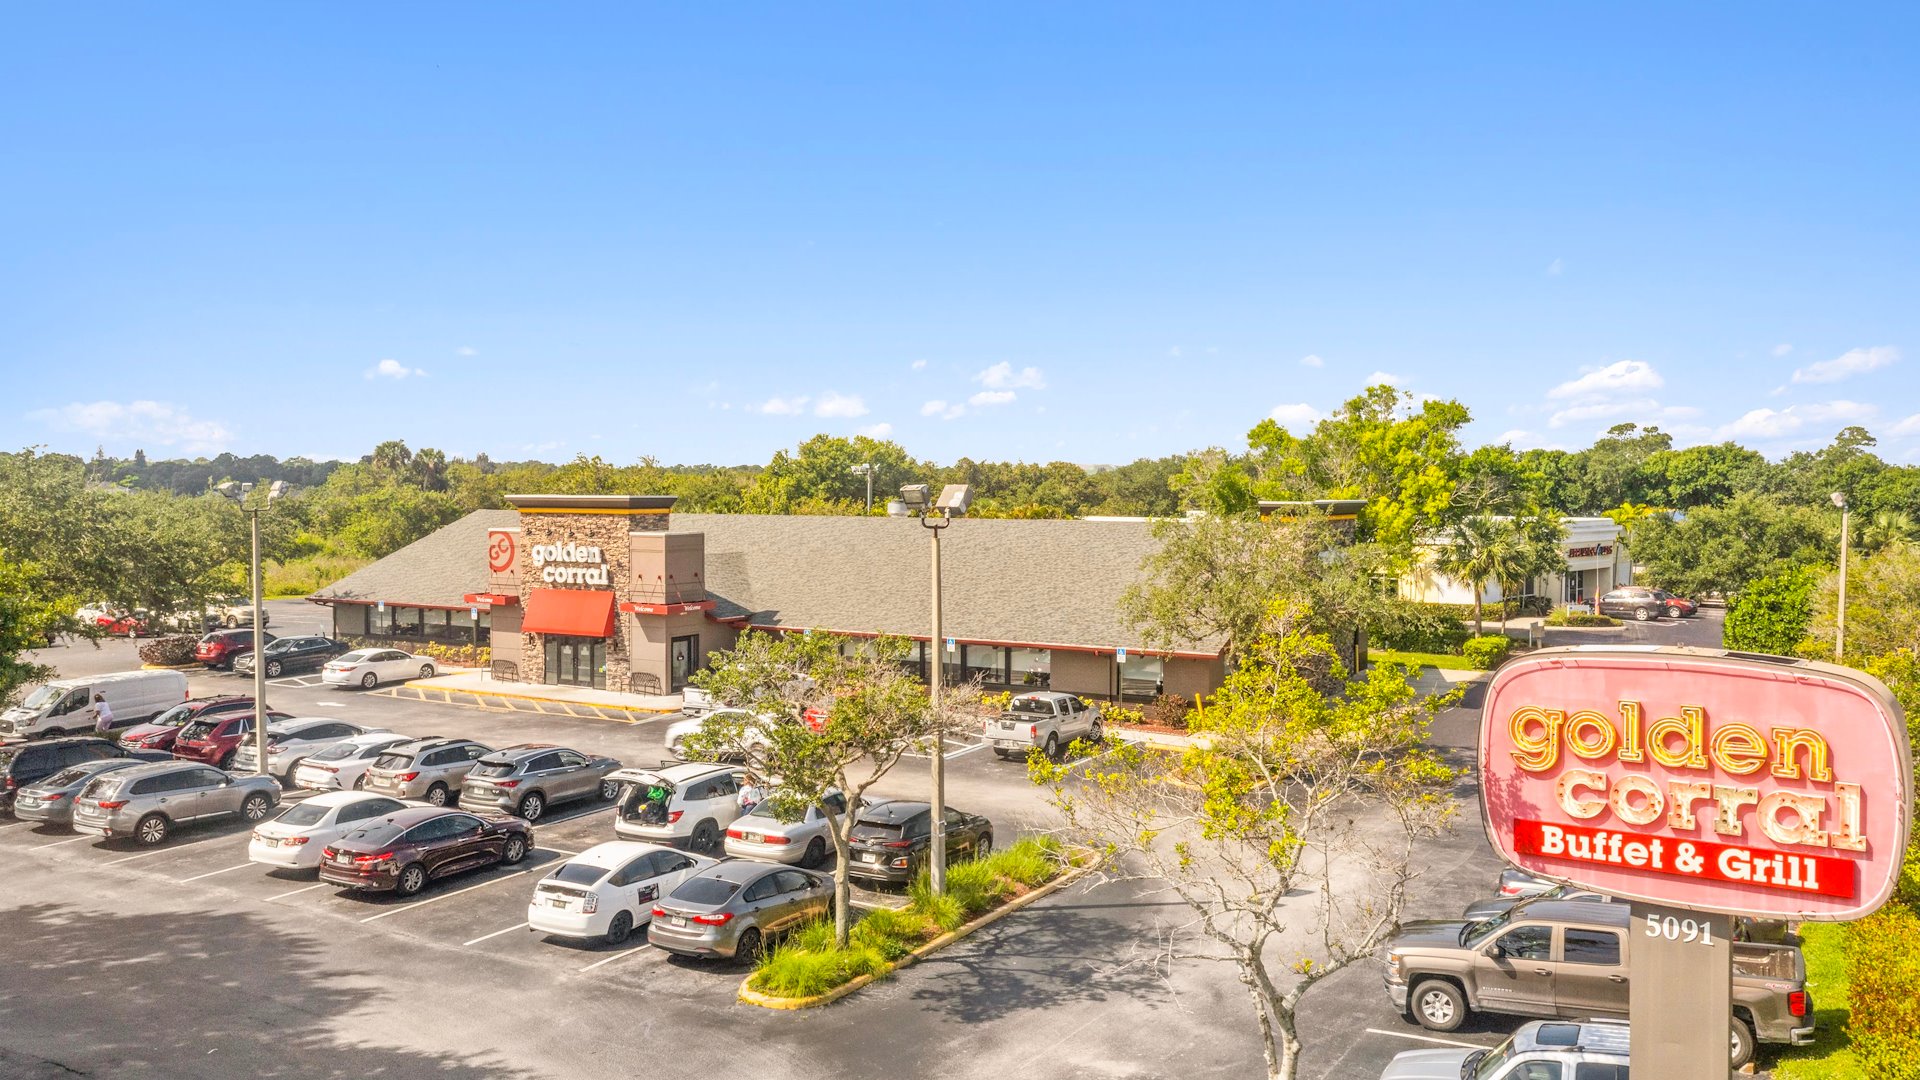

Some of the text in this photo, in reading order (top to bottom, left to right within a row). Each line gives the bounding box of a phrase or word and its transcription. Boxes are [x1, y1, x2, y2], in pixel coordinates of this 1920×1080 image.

[531, 541, 602, 566] golden
[543, 564, 609, 585] corral
[633, 605, 654, 613] Welcome
[1507, 699, 1833, 783] golden
[1555, 768, 1867, 852] corral
[1541, 825, 1819, 890] Buffet & Grill
[1644, 913, 1715, 947] 5091
